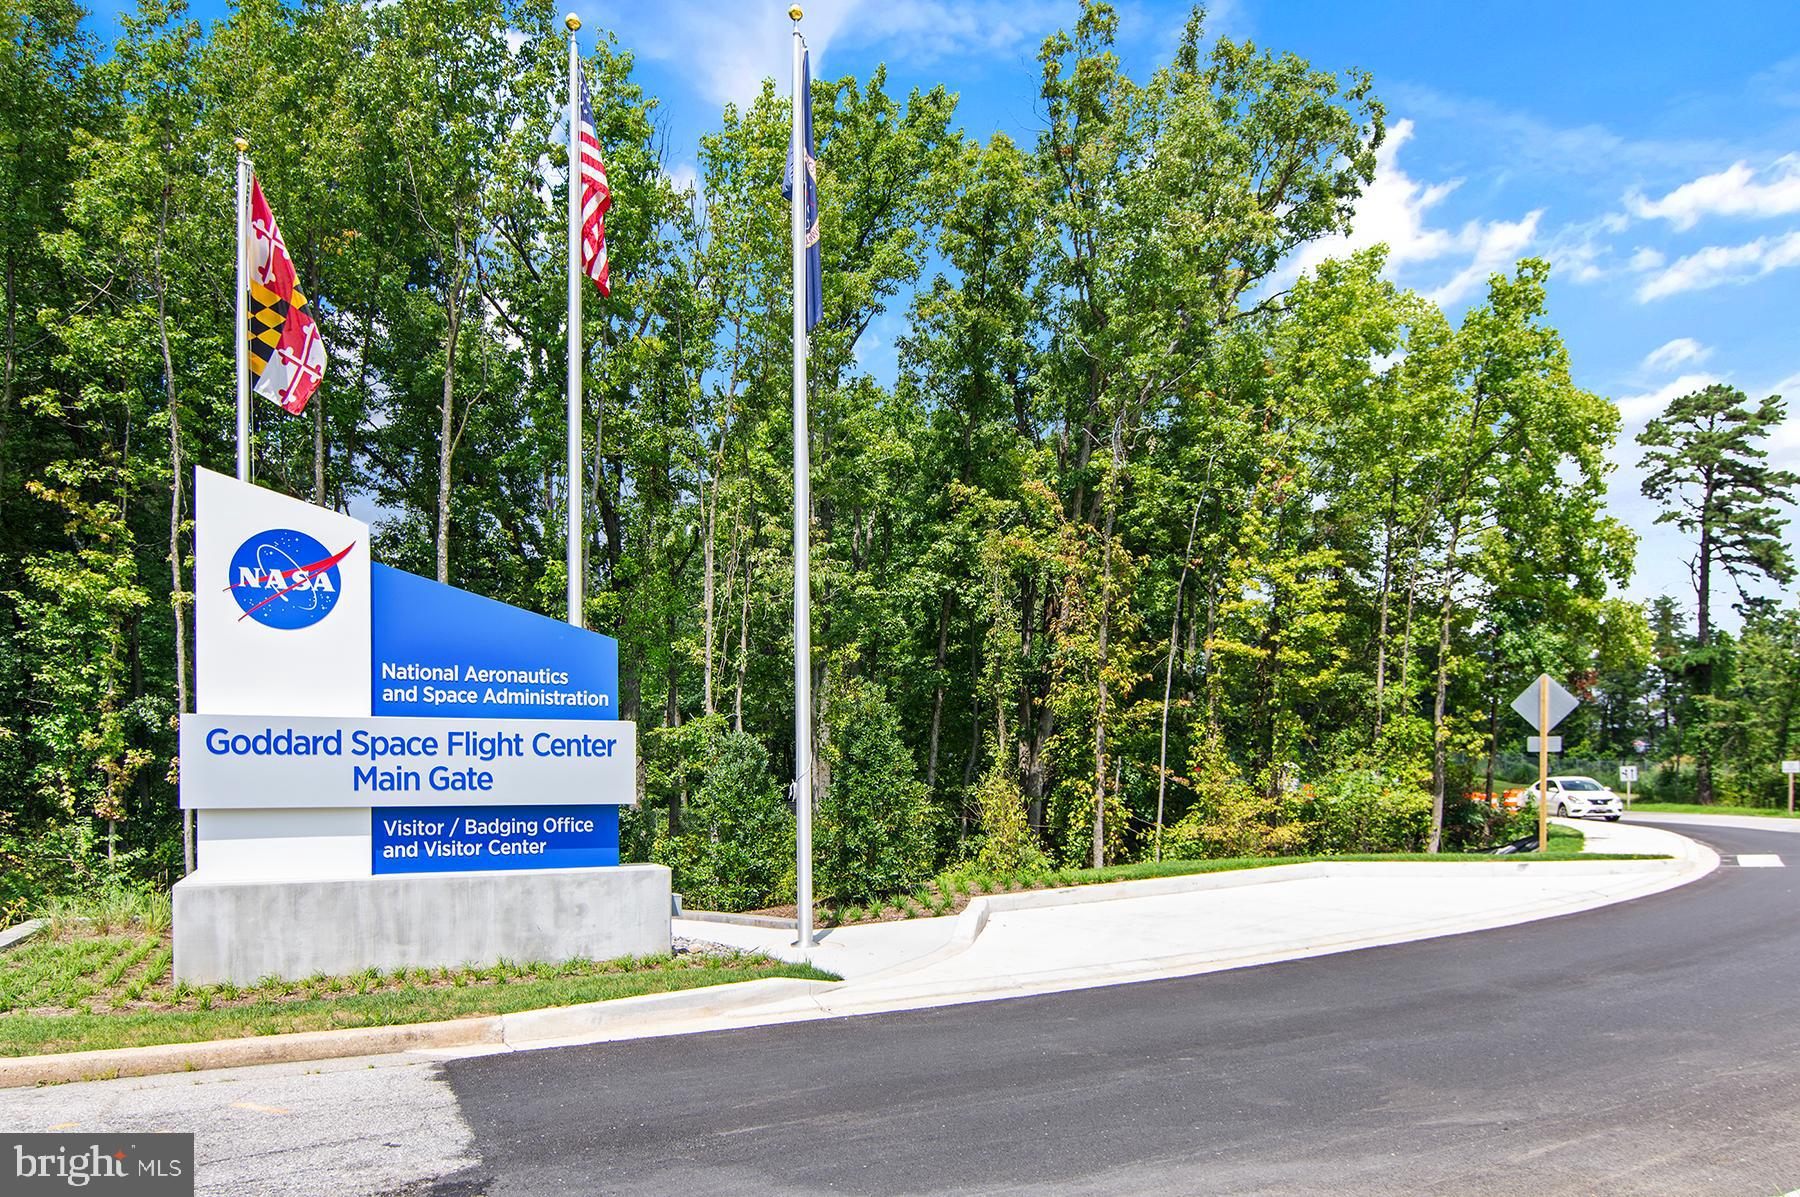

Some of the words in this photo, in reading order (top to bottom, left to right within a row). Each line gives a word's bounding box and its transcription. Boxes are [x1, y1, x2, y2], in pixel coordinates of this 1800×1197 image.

[238, 566, 336, 592] NASA
[382, 662, 459, 682] National
[465, 665, 569, 685] Aeronautics
[382, 685, 418, 702] and
[423, 686, 478, 706] Space
[483, 687, 609, 707] Administration
[205, 727, 342, 757] Goddard
[351, 729, 438, 762] Space
[447, 730, 524, 762] Flight
[532, 731, 617, 758] Center
[353, 764, 420, 792] Main
[428, 765, 494, 792] Gate
[383, 819, 445, 837] Visitor
[449, 817, 460, 837] /
[465, 817, 538, 838] Badging
[543, 816, 594, 834] Office
[383, 841, 418, 859] and
[423, 839, 482, 857] Visitor
[488, 839, 547, 856] Center
